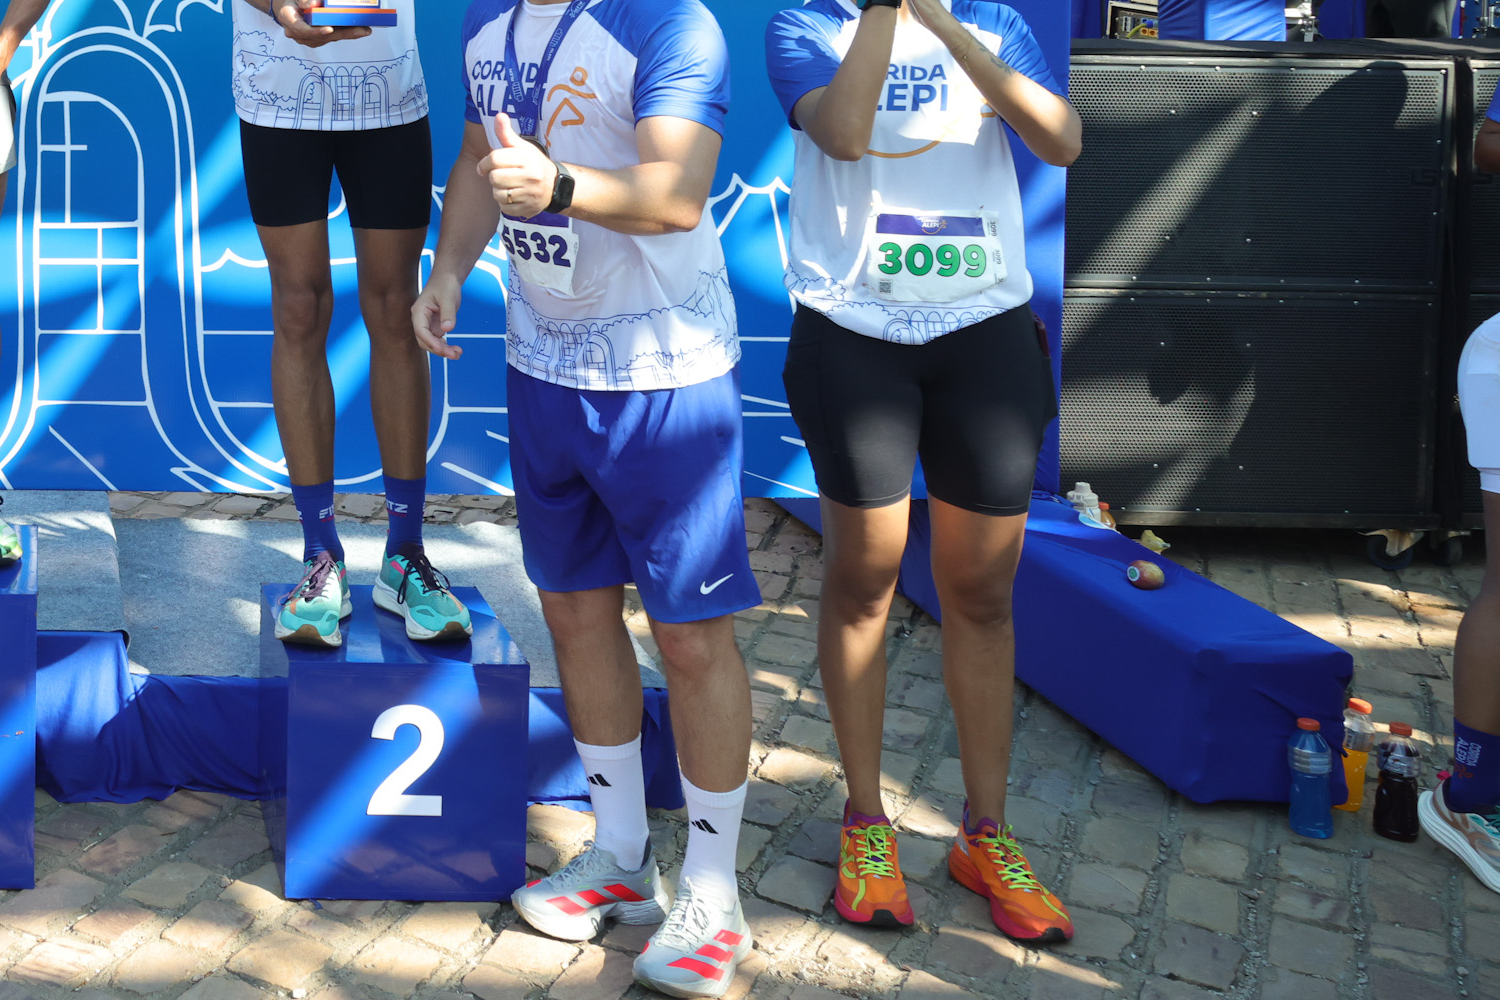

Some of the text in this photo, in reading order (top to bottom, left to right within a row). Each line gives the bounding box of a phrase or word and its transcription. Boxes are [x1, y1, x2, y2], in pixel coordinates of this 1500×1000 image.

[501, 224, 571, 268] 5532
[878, 242, 986, 277] 3099
[366, 704, 445, 817] 2
